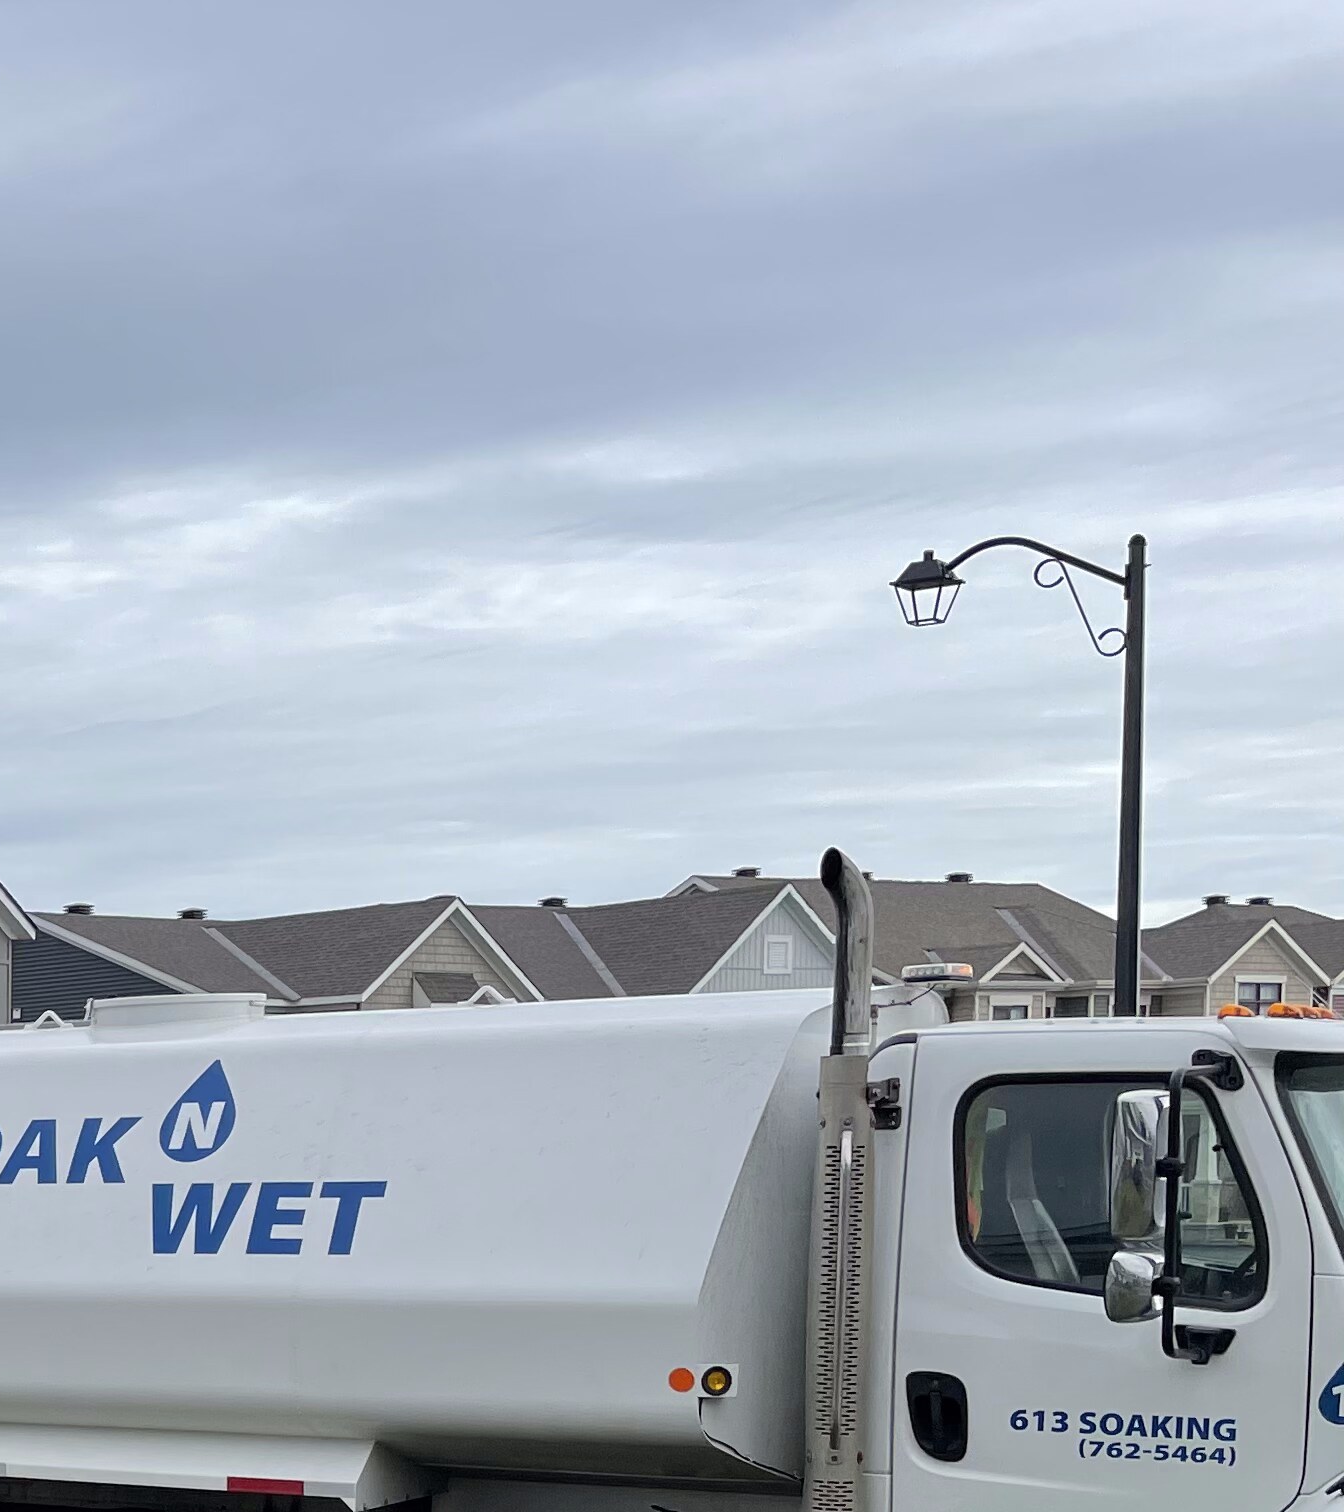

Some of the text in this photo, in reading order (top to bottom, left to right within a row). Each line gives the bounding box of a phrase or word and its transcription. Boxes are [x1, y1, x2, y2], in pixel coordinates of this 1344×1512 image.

[168, 1101, 227, 1150] N
[152, 1181, 388, 1254] WET
[1010, 1409, 1237, 1442] 613 SOAKING
[1078, 1438, 1237, 1467] (762-5464)
